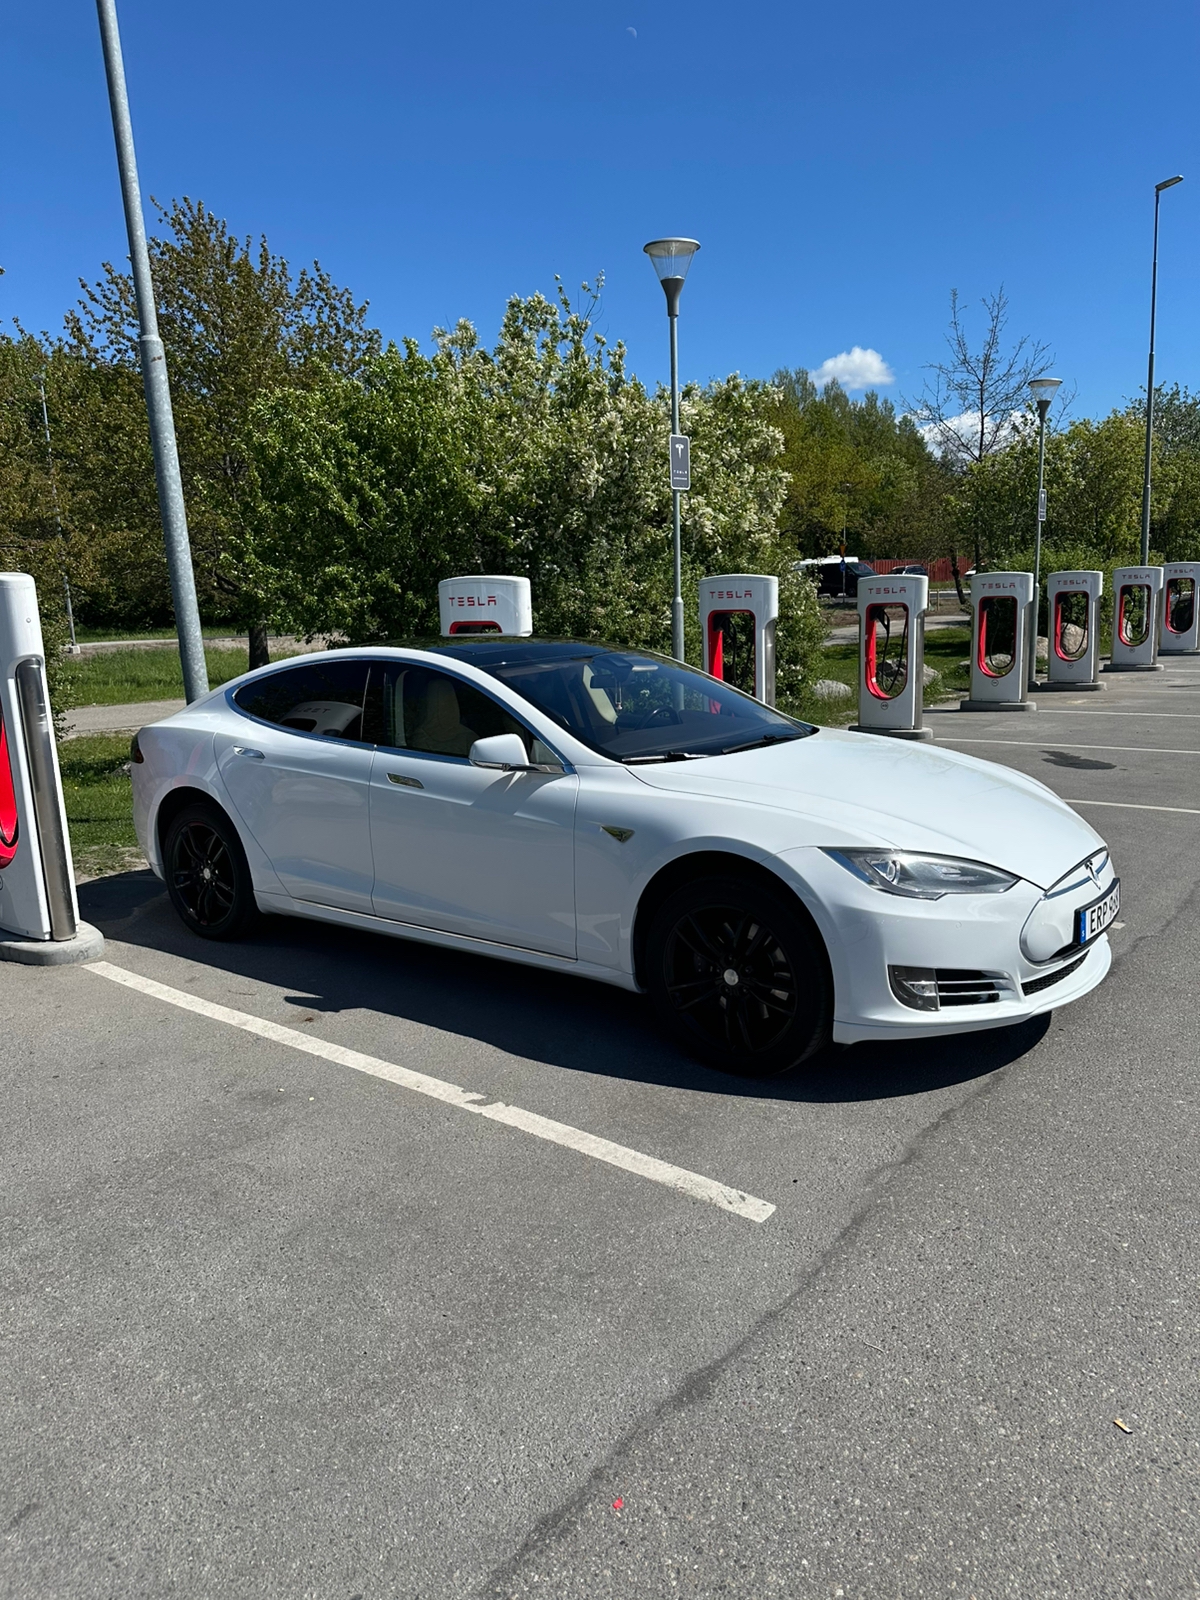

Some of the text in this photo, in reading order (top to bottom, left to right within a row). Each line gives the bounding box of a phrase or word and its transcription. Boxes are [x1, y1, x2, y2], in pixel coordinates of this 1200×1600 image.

[709, 590, 753, 599] TESLA
[868, 586, 907, 595] TESLA
[448, 595, 497, 607] TESLA
[1090, 901, 1108, 934] ERP
